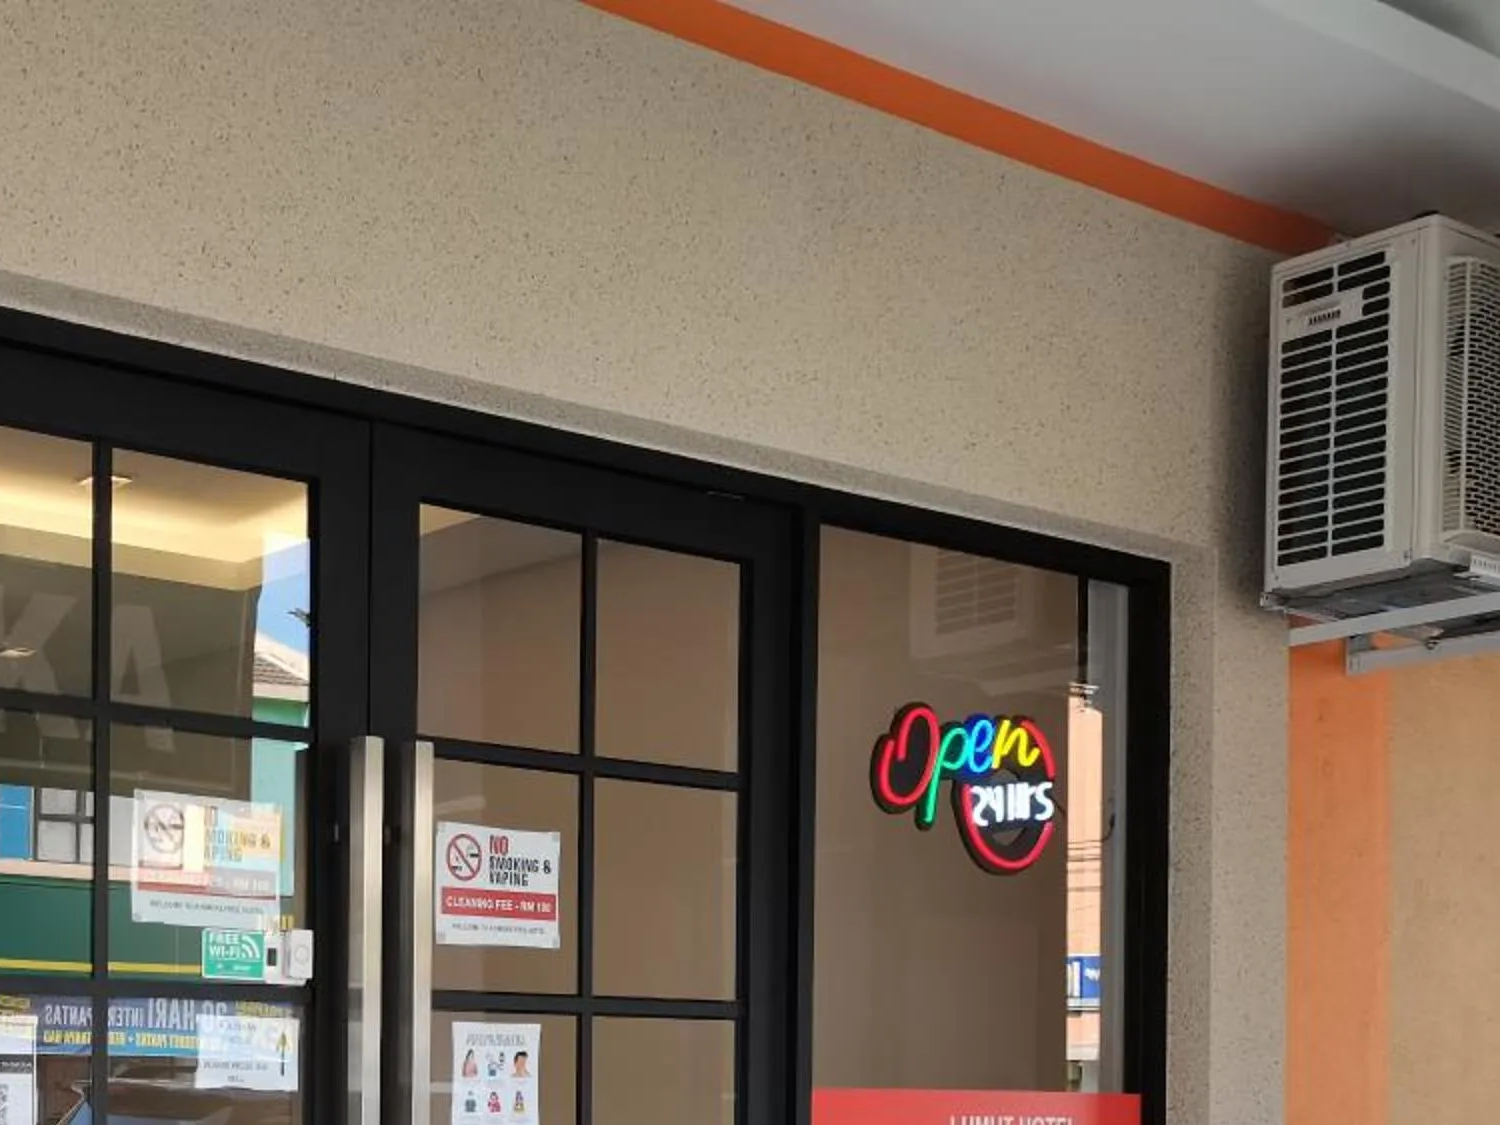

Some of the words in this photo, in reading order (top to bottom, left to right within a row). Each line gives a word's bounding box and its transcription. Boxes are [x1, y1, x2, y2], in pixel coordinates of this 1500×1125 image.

[878, 704, 1041, 825] Open
[489, 834, 509, 857] NO
[489, 855, 539, 874] SMOKING
[543, 859, 552, 875] &
[489, 871, 529, 887] VAPING
[445, 895, 494, 911] CLEANING
[495, 898, 513, 912] FEE
[208, 932, 240, 945] FREE
